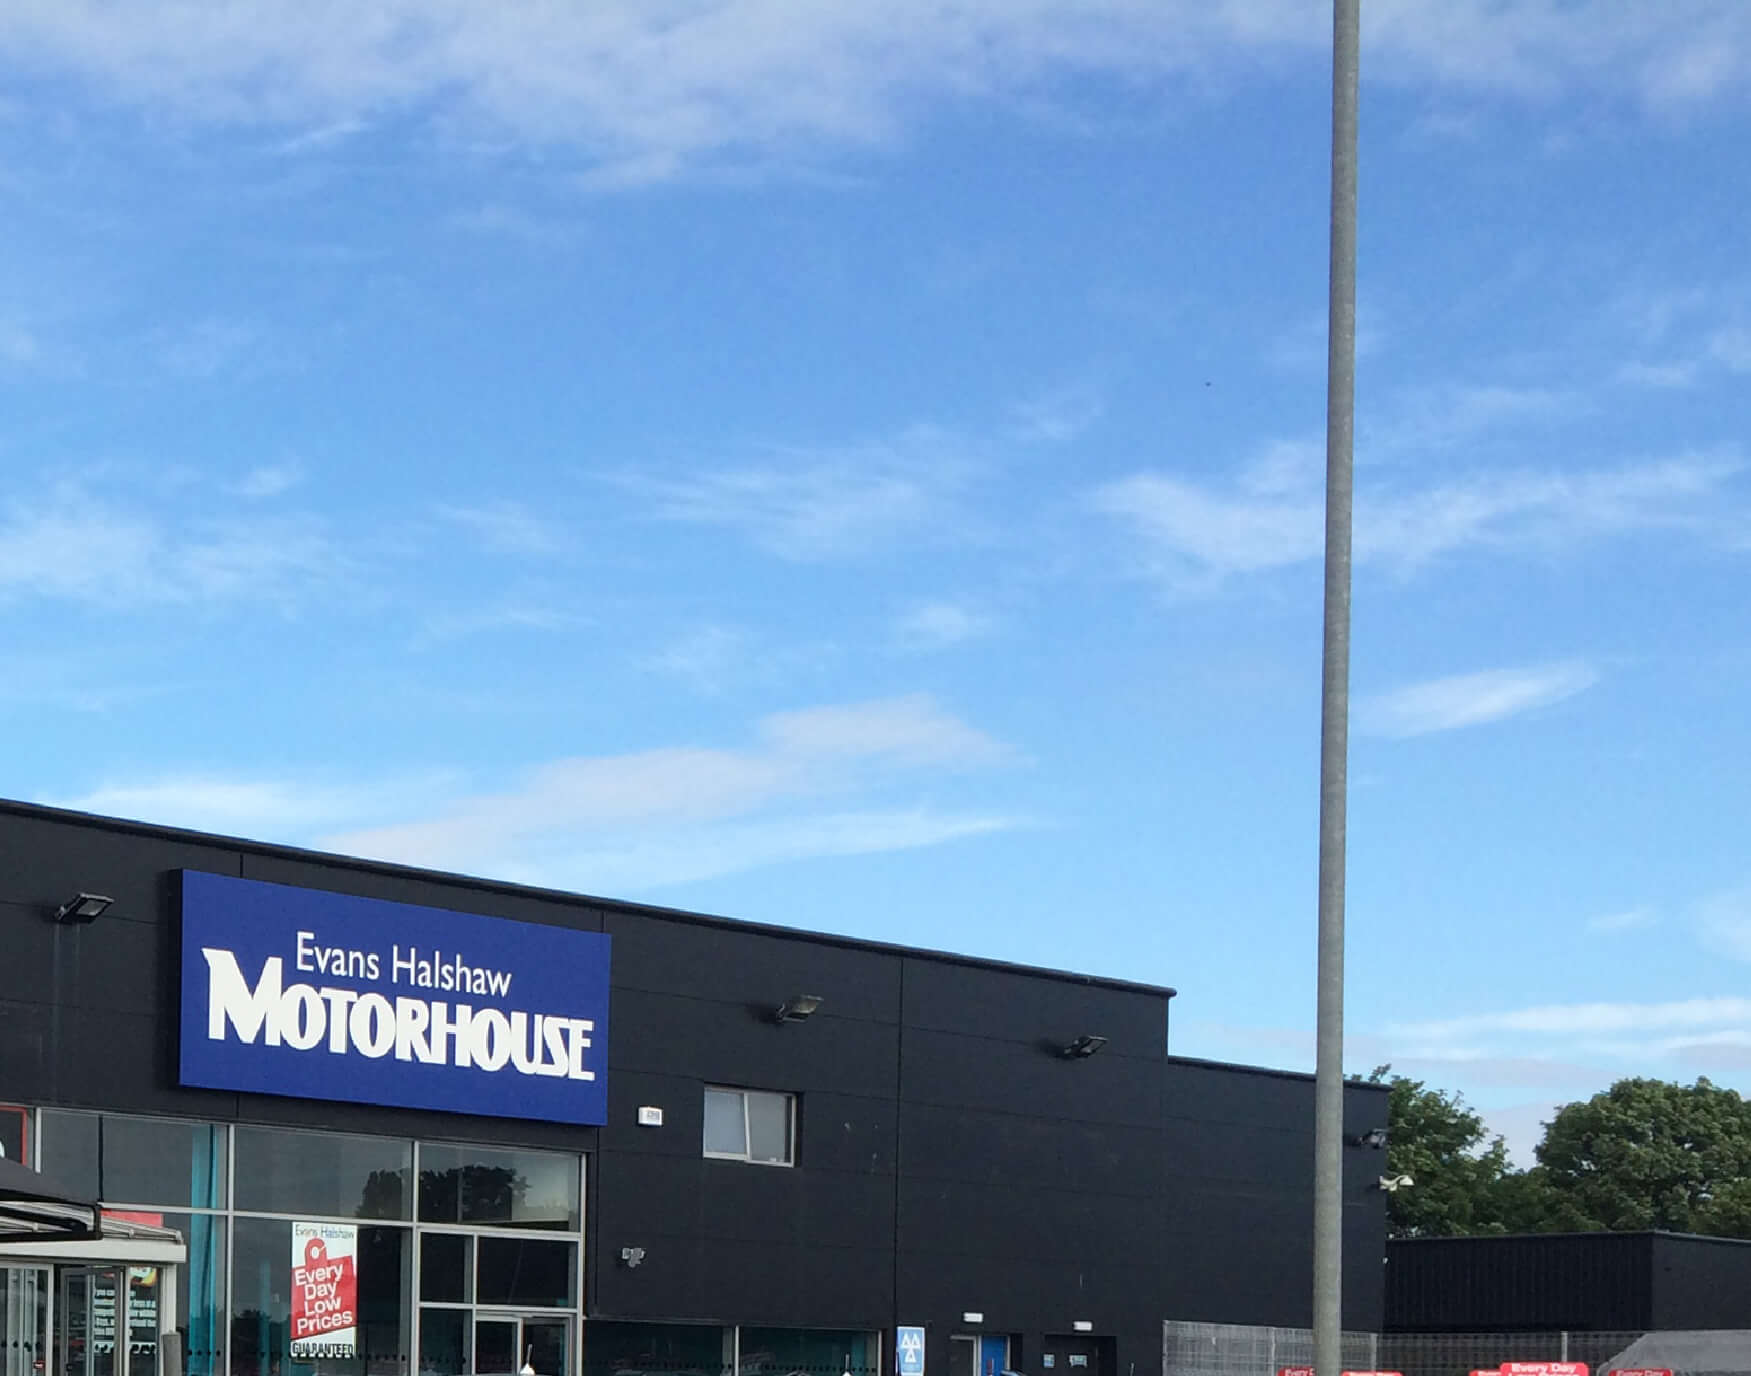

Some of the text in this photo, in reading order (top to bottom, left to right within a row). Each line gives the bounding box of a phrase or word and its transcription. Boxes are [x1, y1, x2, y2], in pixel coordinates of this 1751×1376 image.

[296, 931, 512, 997] Evans Halshaw
[201, 947, 595, 1081] MOTORHOUSE
[294, 1263, 344, 1287] Every
[304, 1281, 337, 1300] Day
[304, 1296, 342, 1317] Low
[297, 1310, 353, 1336] Prices
[291, 1341, 354, 1357] GUARANTEED
[1512, 1363, 1577, 1374] Every Day
